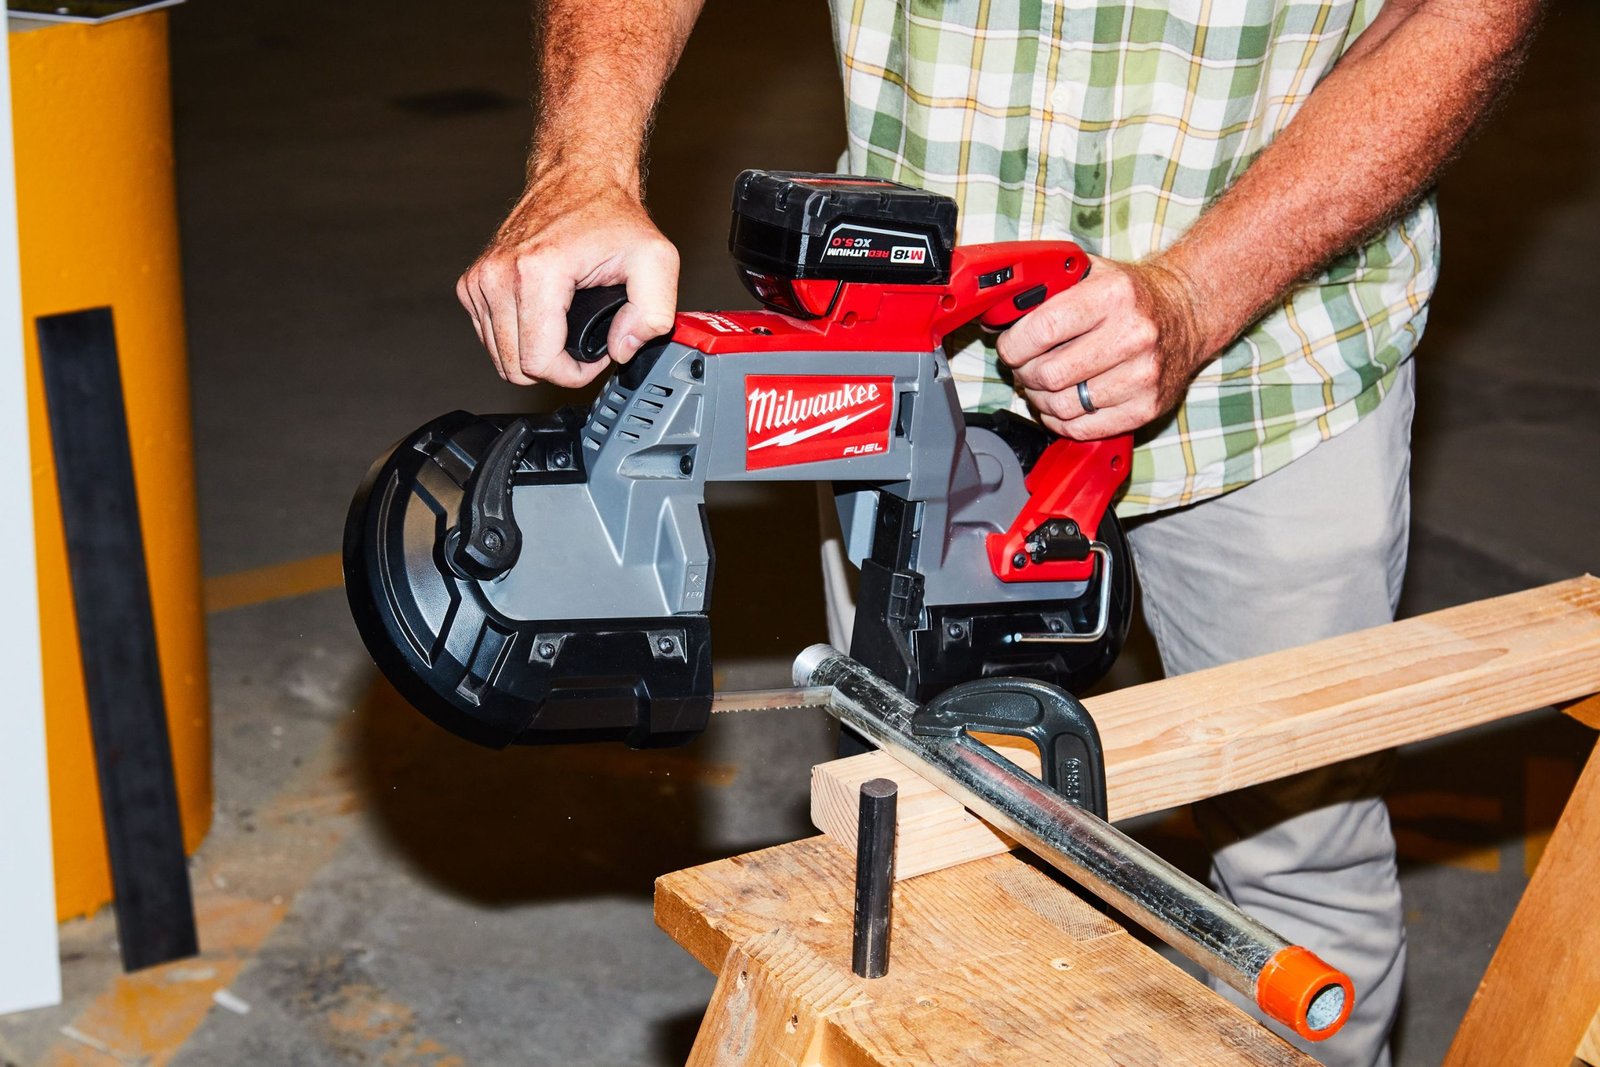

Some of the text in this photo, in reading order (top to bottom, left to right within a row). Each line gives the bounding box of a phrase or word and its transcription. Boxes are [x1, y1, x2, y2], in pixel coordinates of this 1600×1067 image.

[832, 237, 872, 248] XC5.0
[826, 247, 924, 261] M18 REDLITHIUM
[996, 274, 1002, 284] 5
[748, 383, 881, 434] Milwaukee
[843, 442, 884, 455] FUEL
